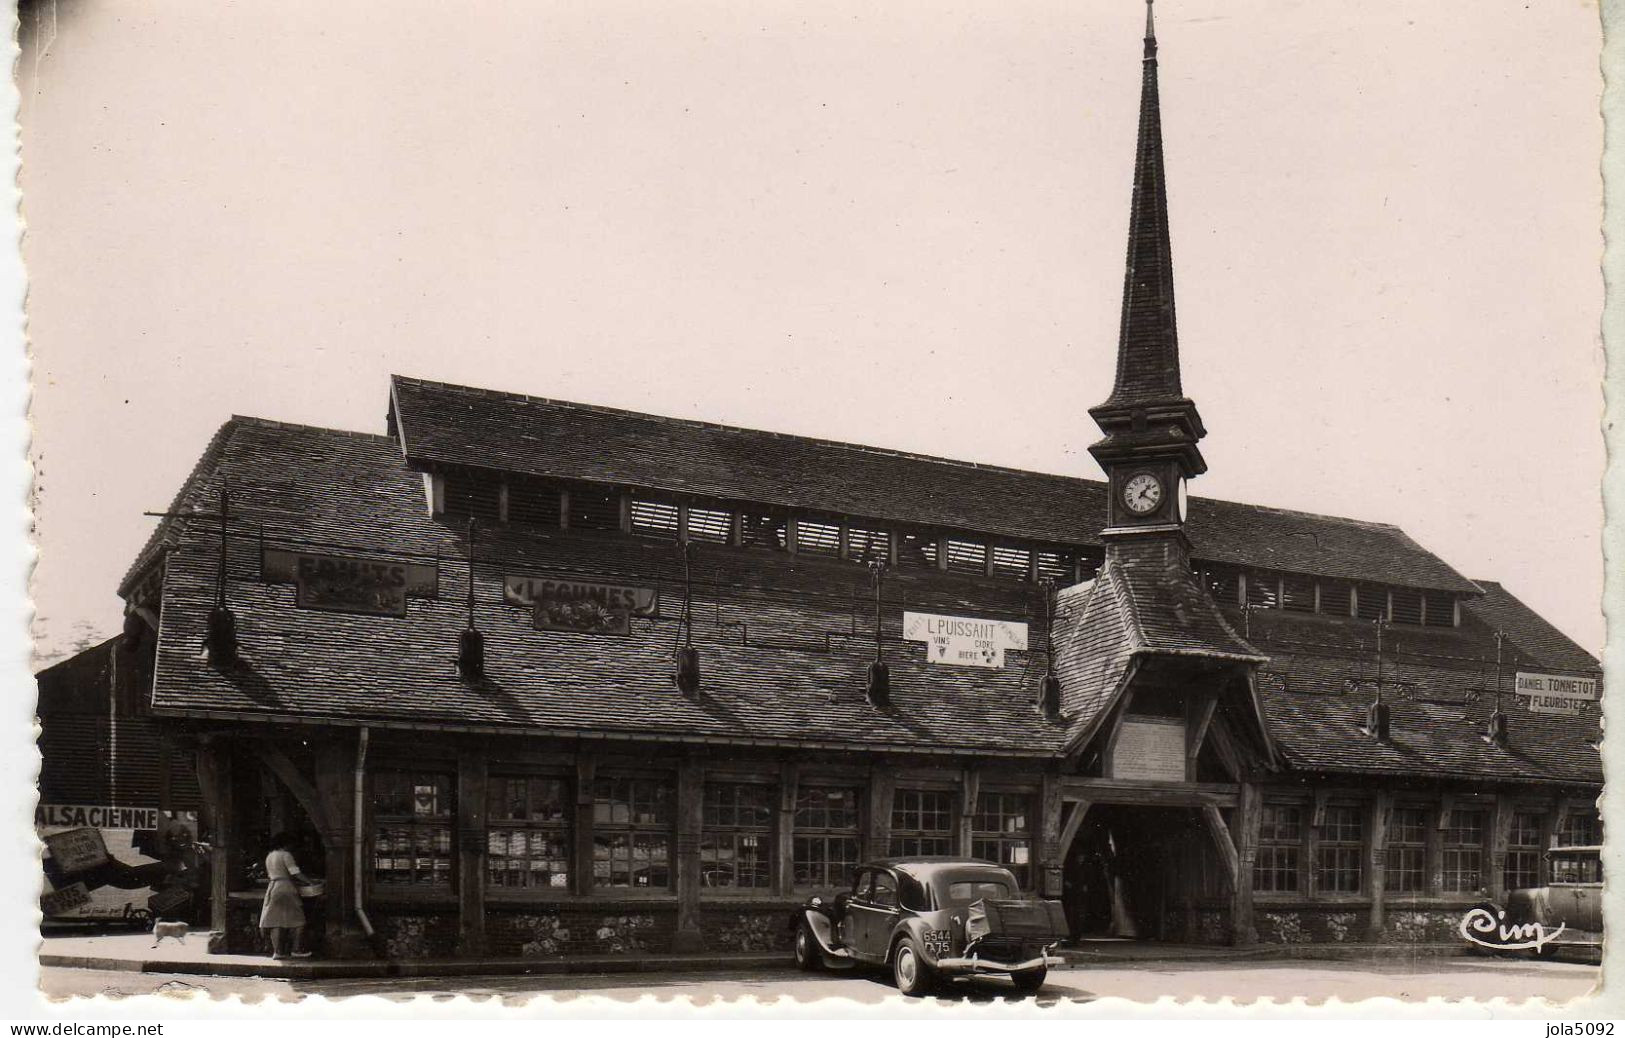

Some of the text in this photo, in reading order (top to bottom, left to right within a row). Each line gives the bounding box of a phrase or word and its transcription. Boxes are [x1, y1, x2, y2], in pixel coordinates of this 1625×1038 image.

[938, 619, 996, 639] PUISSANT
[933, 636, 951, 645] VINS
[974, 640, 994, 650] CIDRE
[1519, 677, 1594, 695] DANIEL TONNETOT
[1532, 695, 1579, 710] FLEURISTE
[34, 804, 158, 829] ALSACIENNE
